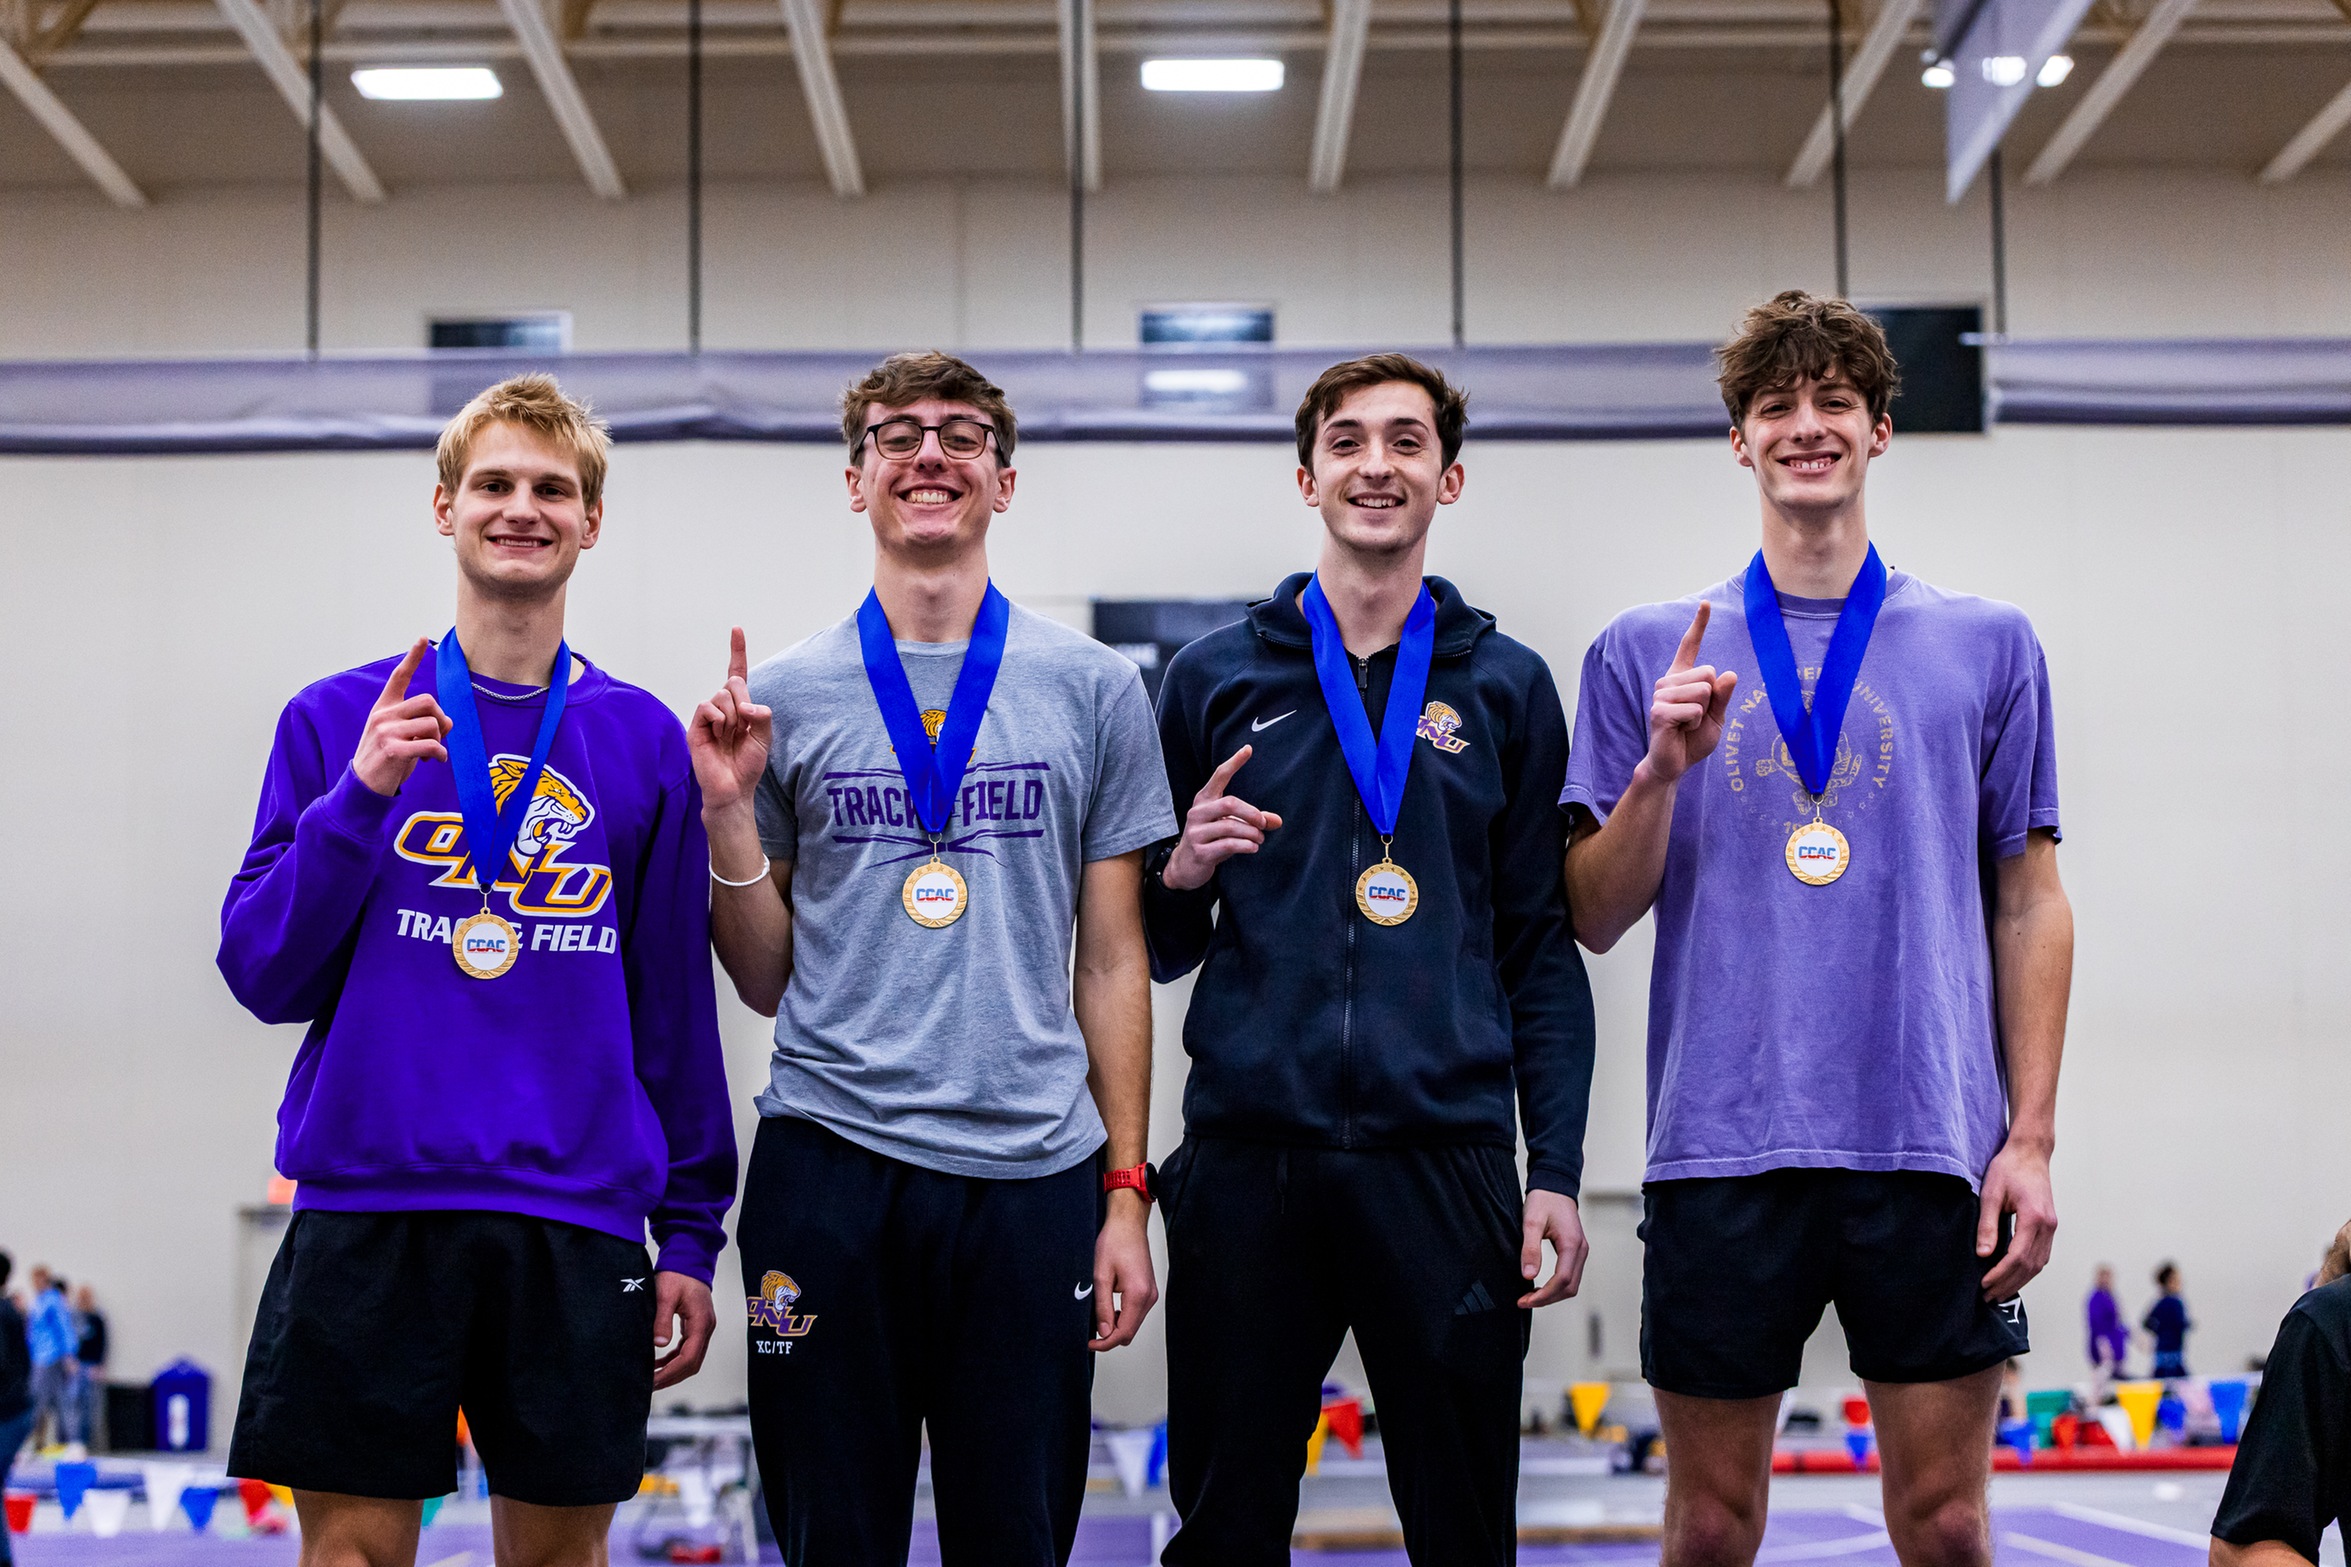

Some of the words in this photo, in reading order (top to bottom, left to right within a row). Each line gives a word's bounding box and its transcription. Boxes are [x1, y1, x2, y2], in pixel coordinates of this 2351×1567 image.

[1725, 718, 1745, 792] OLIVET
[961, 780, 1044, 827] FIELD
[1798, 845, 1836, 860] CCAC
[916, 888, 955, 902] CCAC
[1368, 885, 1406, 902] CCAC
[396, 908, 470, 945] TRA
[530, 924, 618, 954] FIELD
[466, 938, 506, 953] CCAC
[755, 1340, 793, 1354] XC/TF
